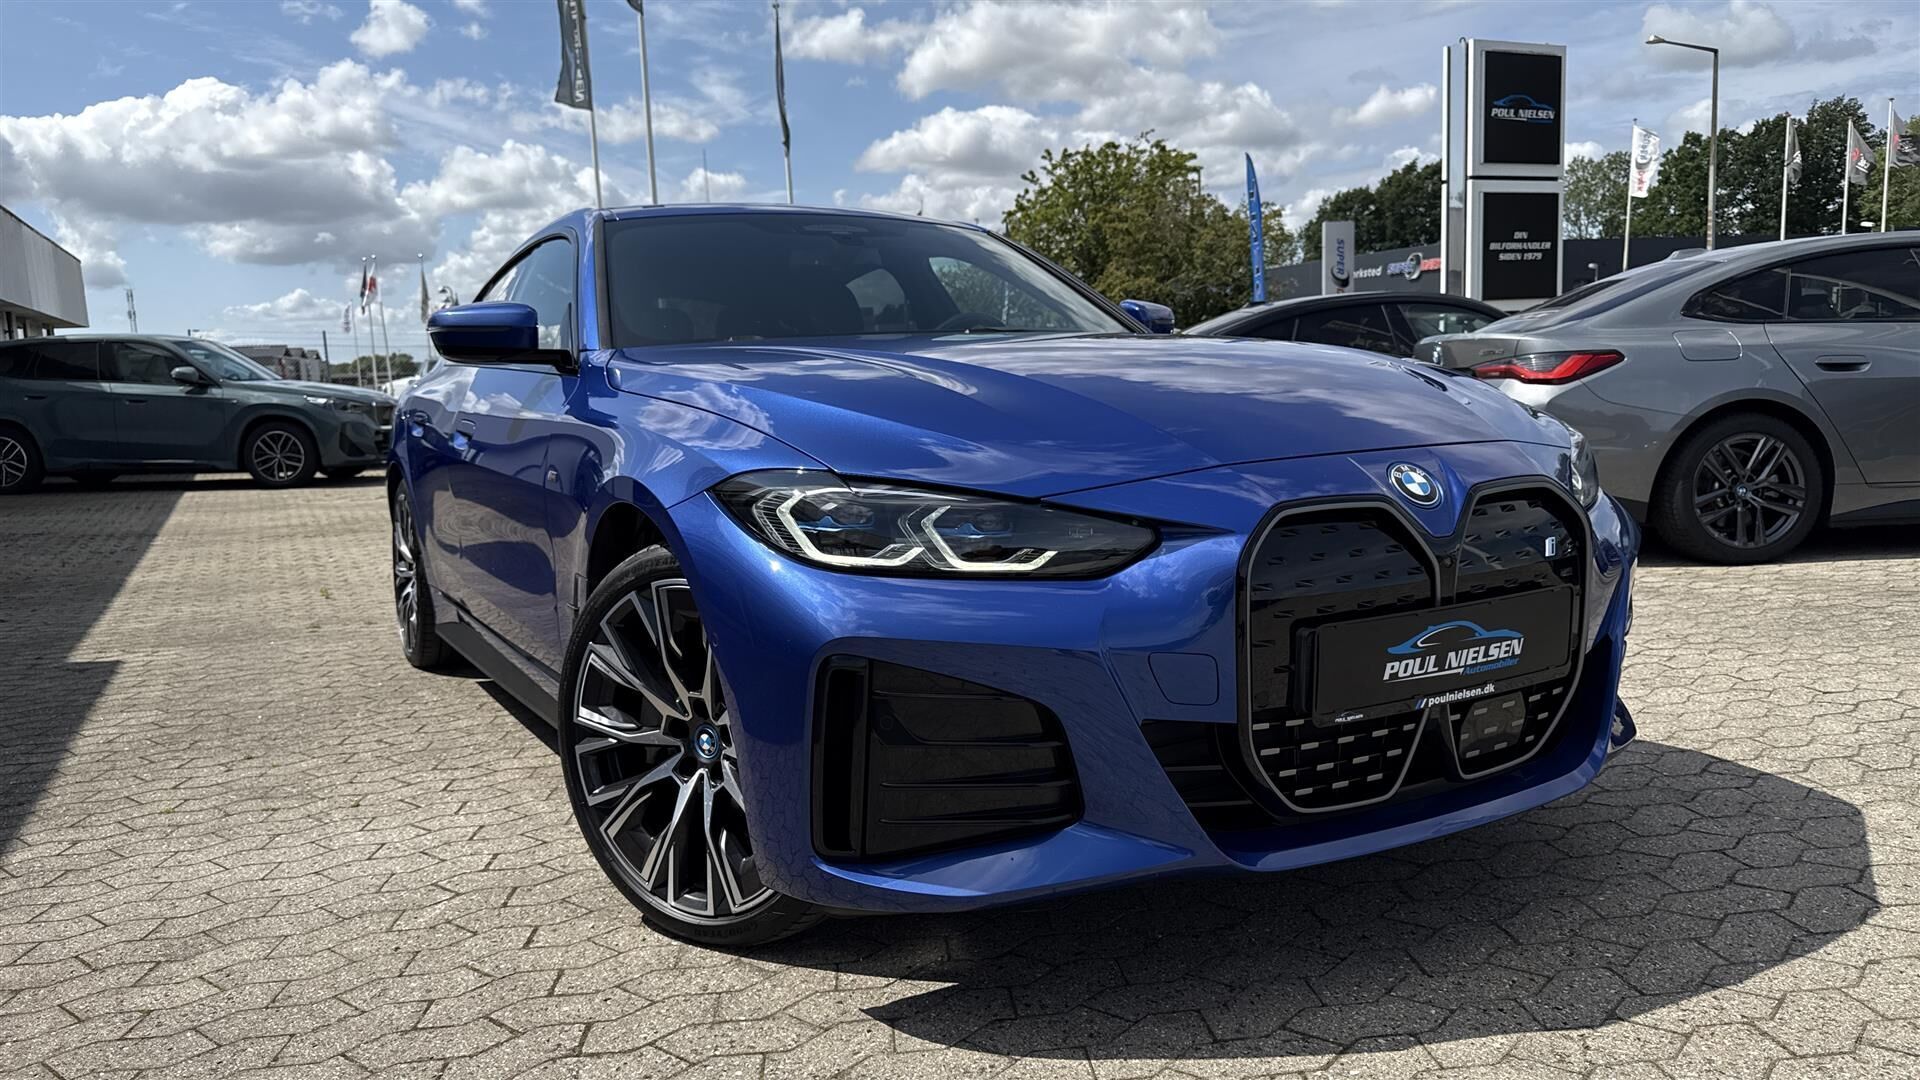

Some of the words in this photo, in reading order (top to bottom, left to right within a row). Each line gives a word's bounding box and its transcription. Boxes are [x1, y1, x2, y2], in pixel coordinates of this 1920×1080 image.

[1490, 107, 1516, 118] POUL
[1517, 109, 1556, 120] NIELSEN
[1513, 231, 1528, 240] DIN
[1336, 239, 1346, 275] SUPER
[1499, 252, 1522, 261] SIDEN
[1523, 252, 1543, 261] 1979
[1383, 654, 1438, 681] POUL
[1444, 637, 1525, 670] NIELSEN
[1463, 657, 1521, 675] Automobiler
[1428, 682, 1495, 707] poulnielsen.dk
